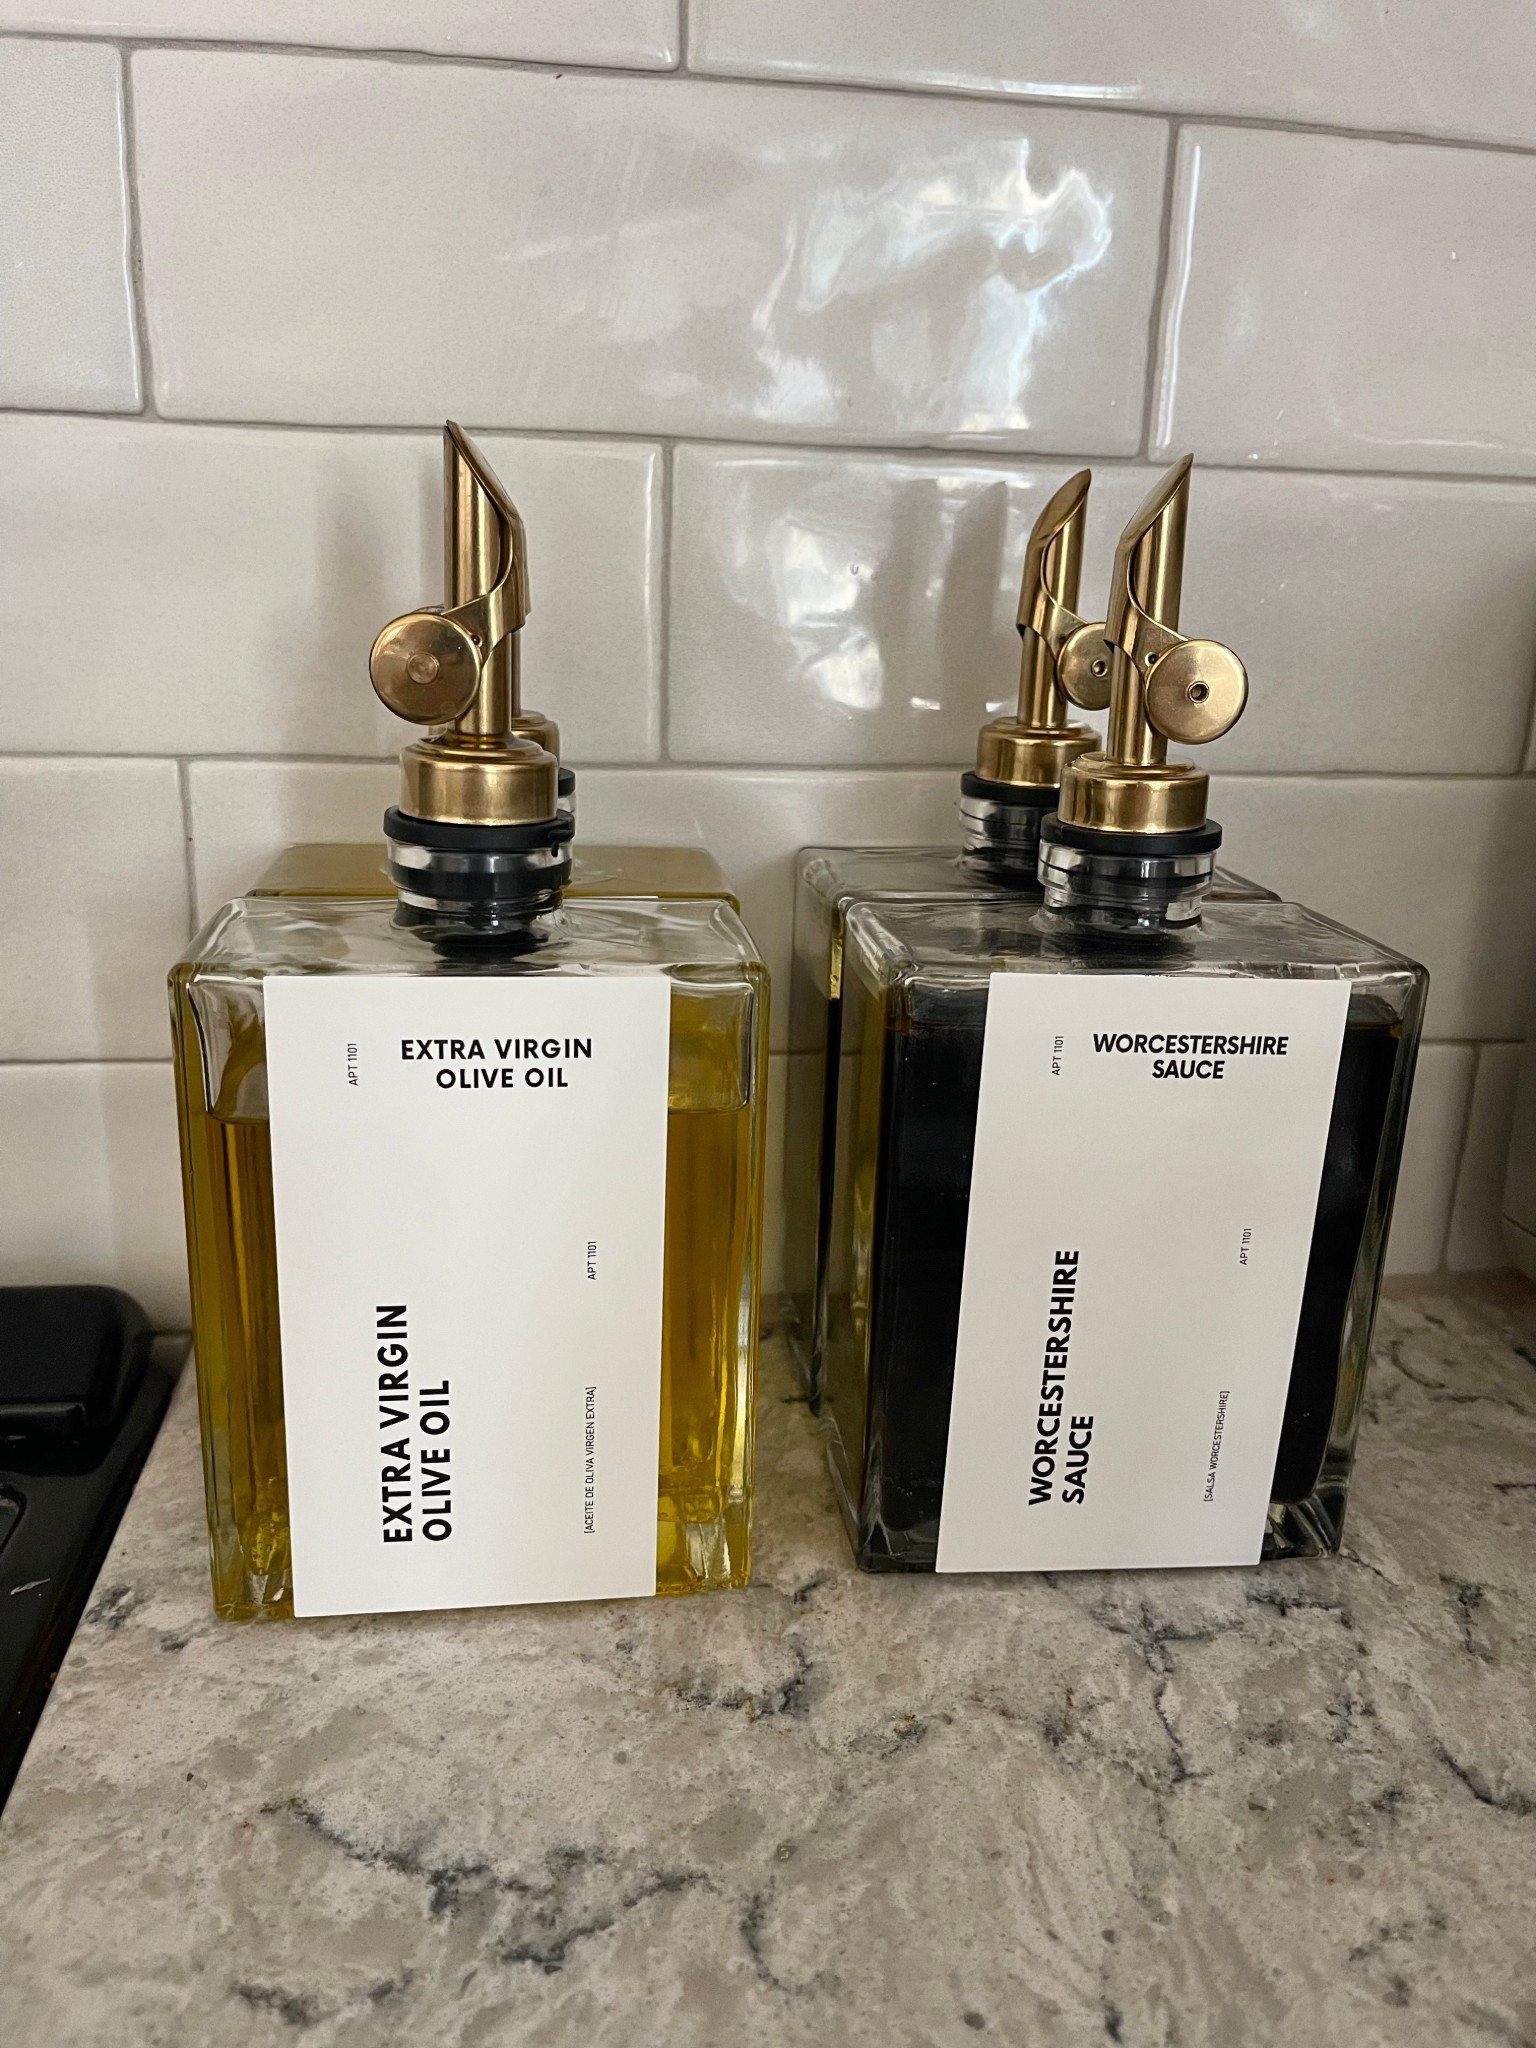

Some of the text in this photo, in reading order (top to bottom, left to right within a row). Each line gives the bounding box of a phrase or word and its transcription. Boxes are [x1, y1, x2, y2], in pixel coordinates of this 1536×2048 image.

[346, 1043, 359, 1086] APT 1101
[401, 1037, 592, 1061] EXTRA VIRGIN
[1051, 1036, 1064, 1076] APT 1101
[1092, 1033, 1290, 1056] WORCESTERSHIRE
[435, 1067, 569, 1090] OLIVE OIL
[1151, 1058, 1226, 1080] SAUCE
[587, 1241, 597, 1281] APT 1101
[1239, 1228, 1252, 1266] APT 1101
[1028, 1250, 1080, 1506] WORCESTERSHIRE
[375, 1304, 413, 1543] EXTRA VIRGIN
[419, 1379, 453, 1542] OLIVE OIL
[583, 1386, 597, 1534] [ACEITE DE OLIVA VIRGEN EXTRA]
[1062, 1415, 1094, 1505] SAUCE
[1202, 1390, 1231, 1502] [SALSA WORCESTERSHIRE]
